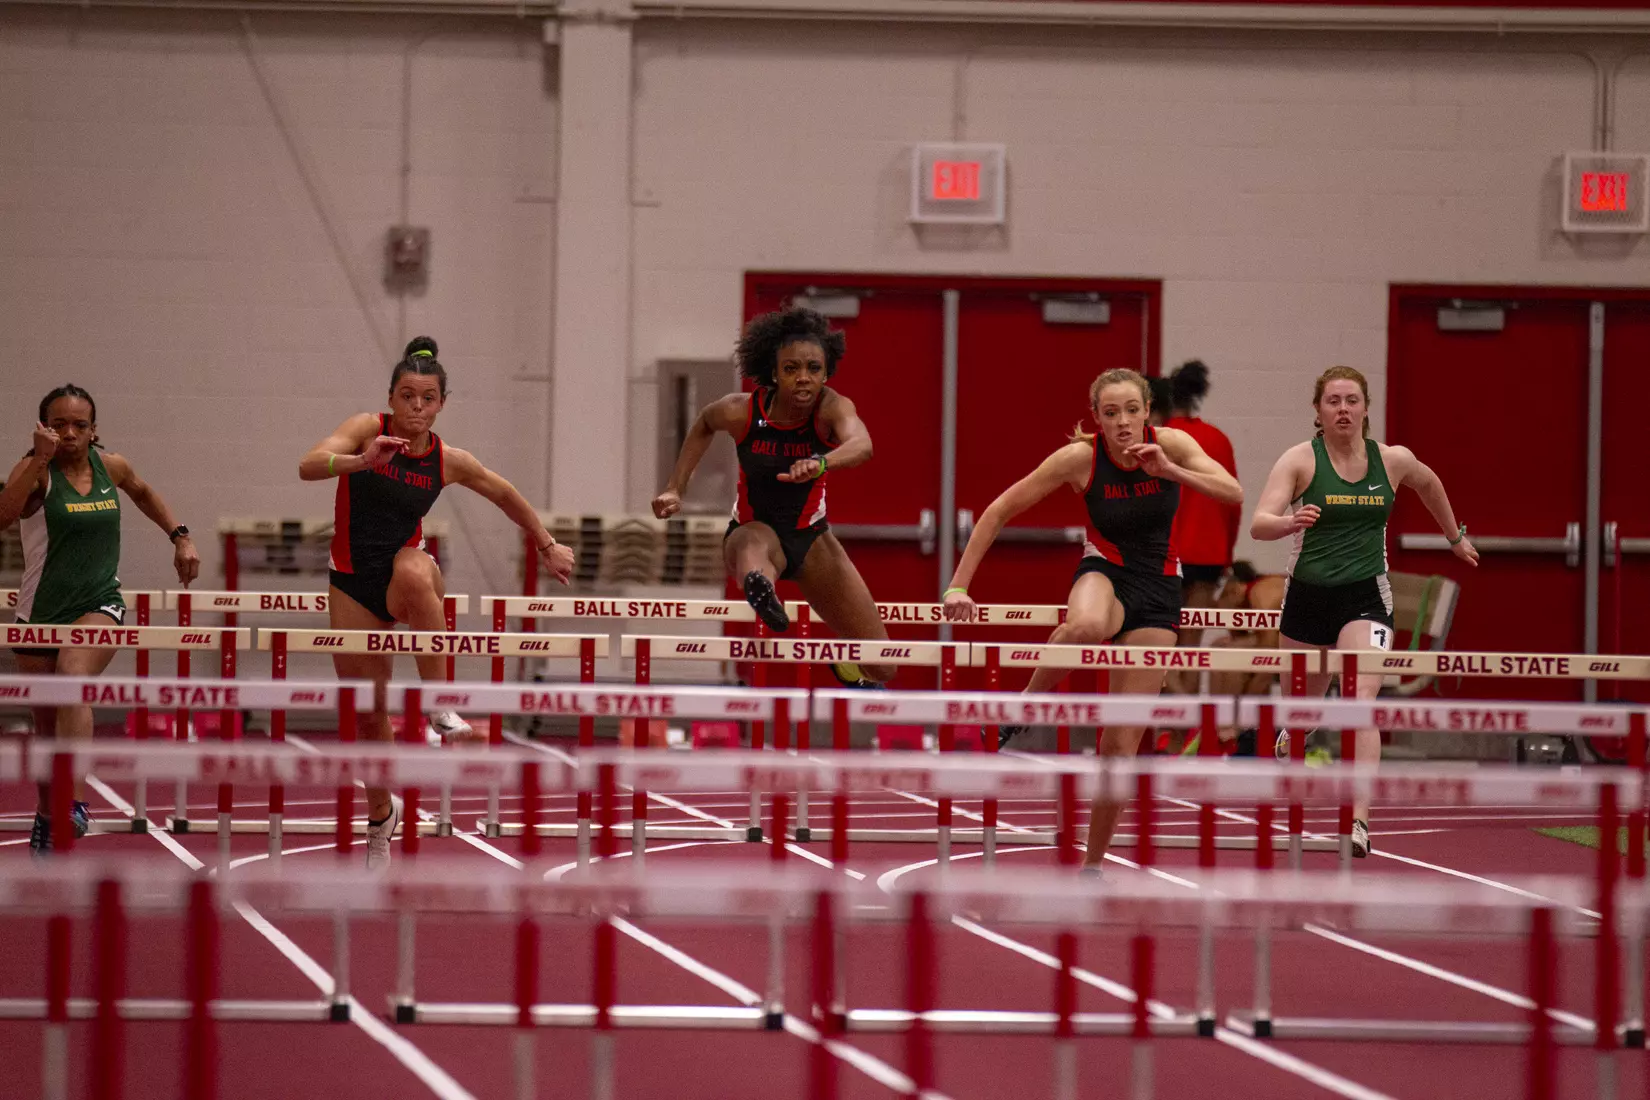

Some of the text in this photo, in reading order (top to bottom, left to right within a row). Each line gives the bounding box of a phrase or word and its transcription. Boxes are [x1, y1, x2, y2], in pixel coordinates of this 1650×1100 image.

[1581, 172, 1630, 211] EXIT
[751, 440, 811, 456] BALL STATE
[404, 471, 433, 490] STATE
[1104, 480, 1161, 498] BALL STATE
[95, 500, 117, 510] STATE
[1358, 495, 1384, 505] STATE
[213, 597, 240, 607] GILL
[260, 595, 308, 611] BALL
[528, 603, 554, 612] GILL
[574, 600, 686, 618] BALL STATE
[703, 606, 729, 616] GILL
[878, 605, 924, 622] BALL
[1005, 611, 1032, 620] GILL
[1179, 611, 1226, 627] BALL
[7, 628, 139, 646] BALL STATE
[181, 633, 211, 645] GILL
[313, 636, 344, 647] GILL
[367, 634, 500, 654] BALL STATE
[519, 640, 550, 651] GILL
[676, 643, 707, 653] GILL
[729, 640, 861, 661] BALL STATE
[880, 648, 911, 658] GILL
[1011, 650, 1040, 661] GILL
[1081, 649, 1211, 668] BALL STATE
[1252, 656, 1281, 666] GILL
[1383, 658, 1414, 668] GILL
[1436, 655, 1570, 676] BALL STATE
[1589, 662, 1620, 672] GILL
[82, 684, 239, 707] BALL STATE
[520, 692, 675, 716] BALL STATE
[946, 700, 1101, 724] BALL STATE
[1372, 708, 1529, 731] BALL STATE
